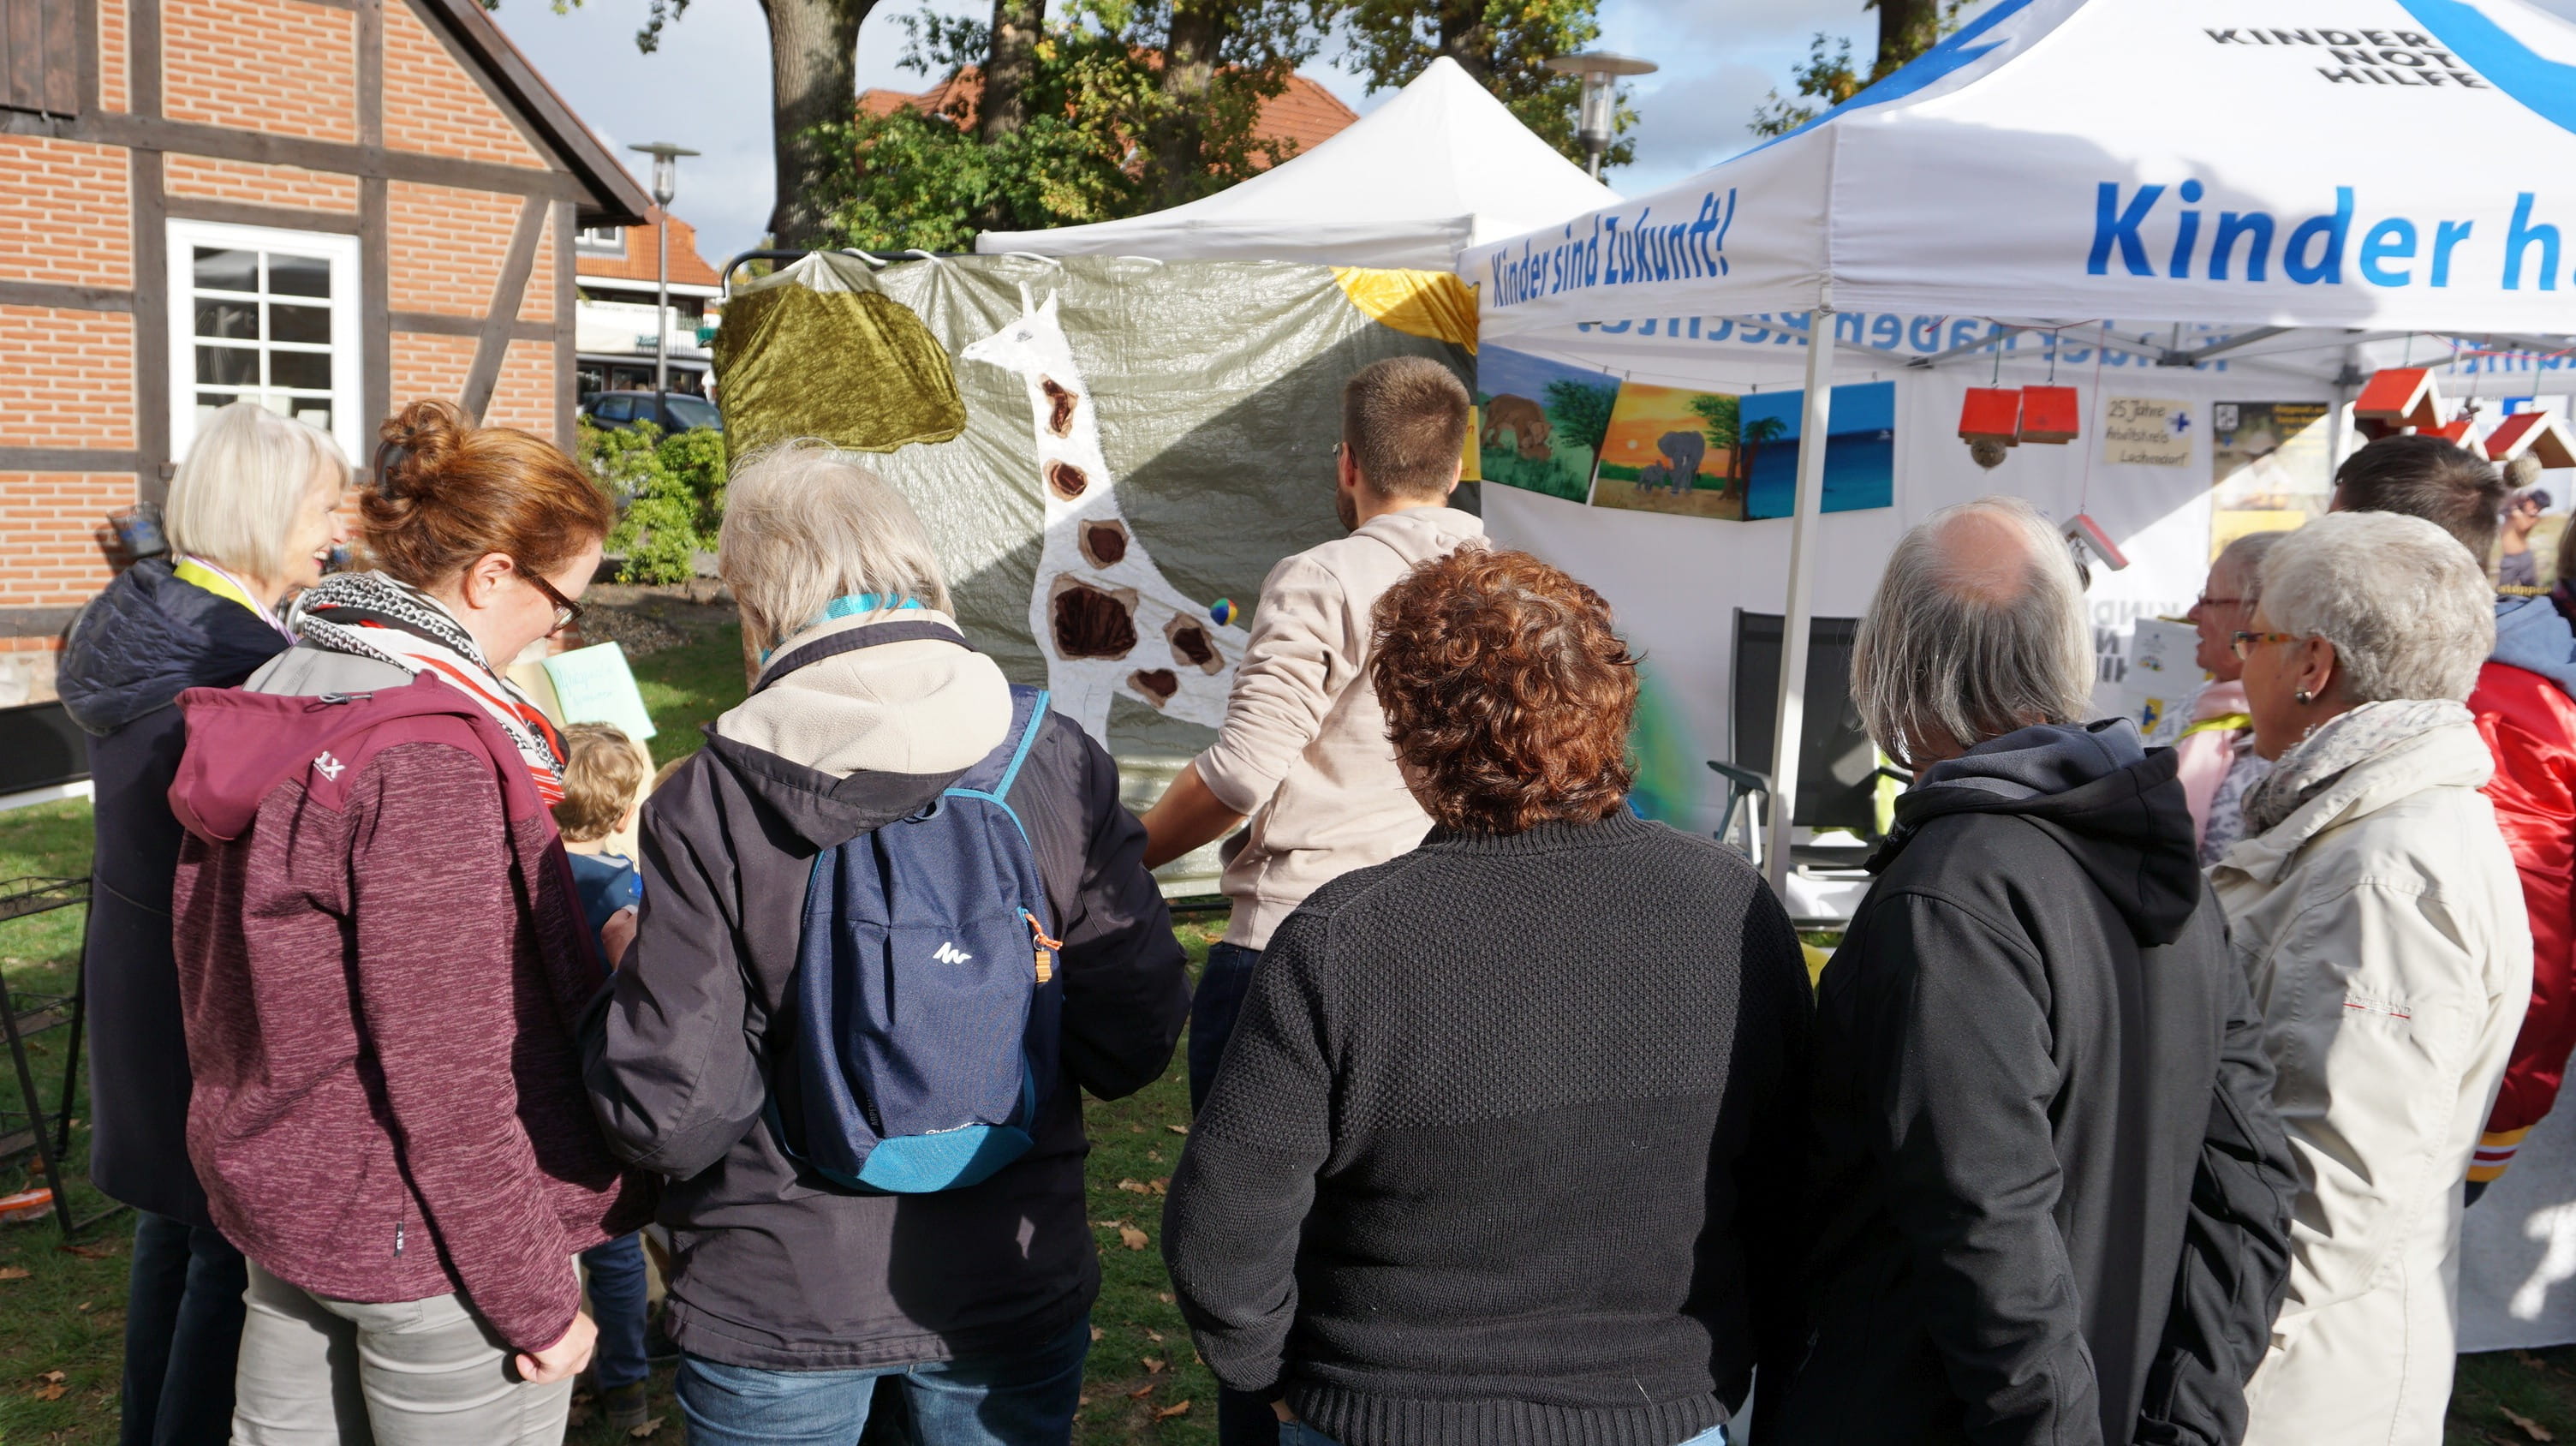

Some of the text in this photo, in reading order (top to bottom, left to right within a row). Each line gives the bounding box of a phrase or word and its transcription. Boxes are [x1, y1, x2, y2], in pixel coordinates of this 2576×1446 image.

[2203, 27, 2440, 48] KINDER
[2329, 48, 2459, 69] NOT
[2316, 67, 2492, 88] HILFE
[2087, 178, 2576, 291] Kinder h
[1492, 188, 1737, 308] Kinder sind Zukunft!
[2108, 399, 2166, 423] 25 Jahre
[867, 1098, 880, 1126] ARPEN
